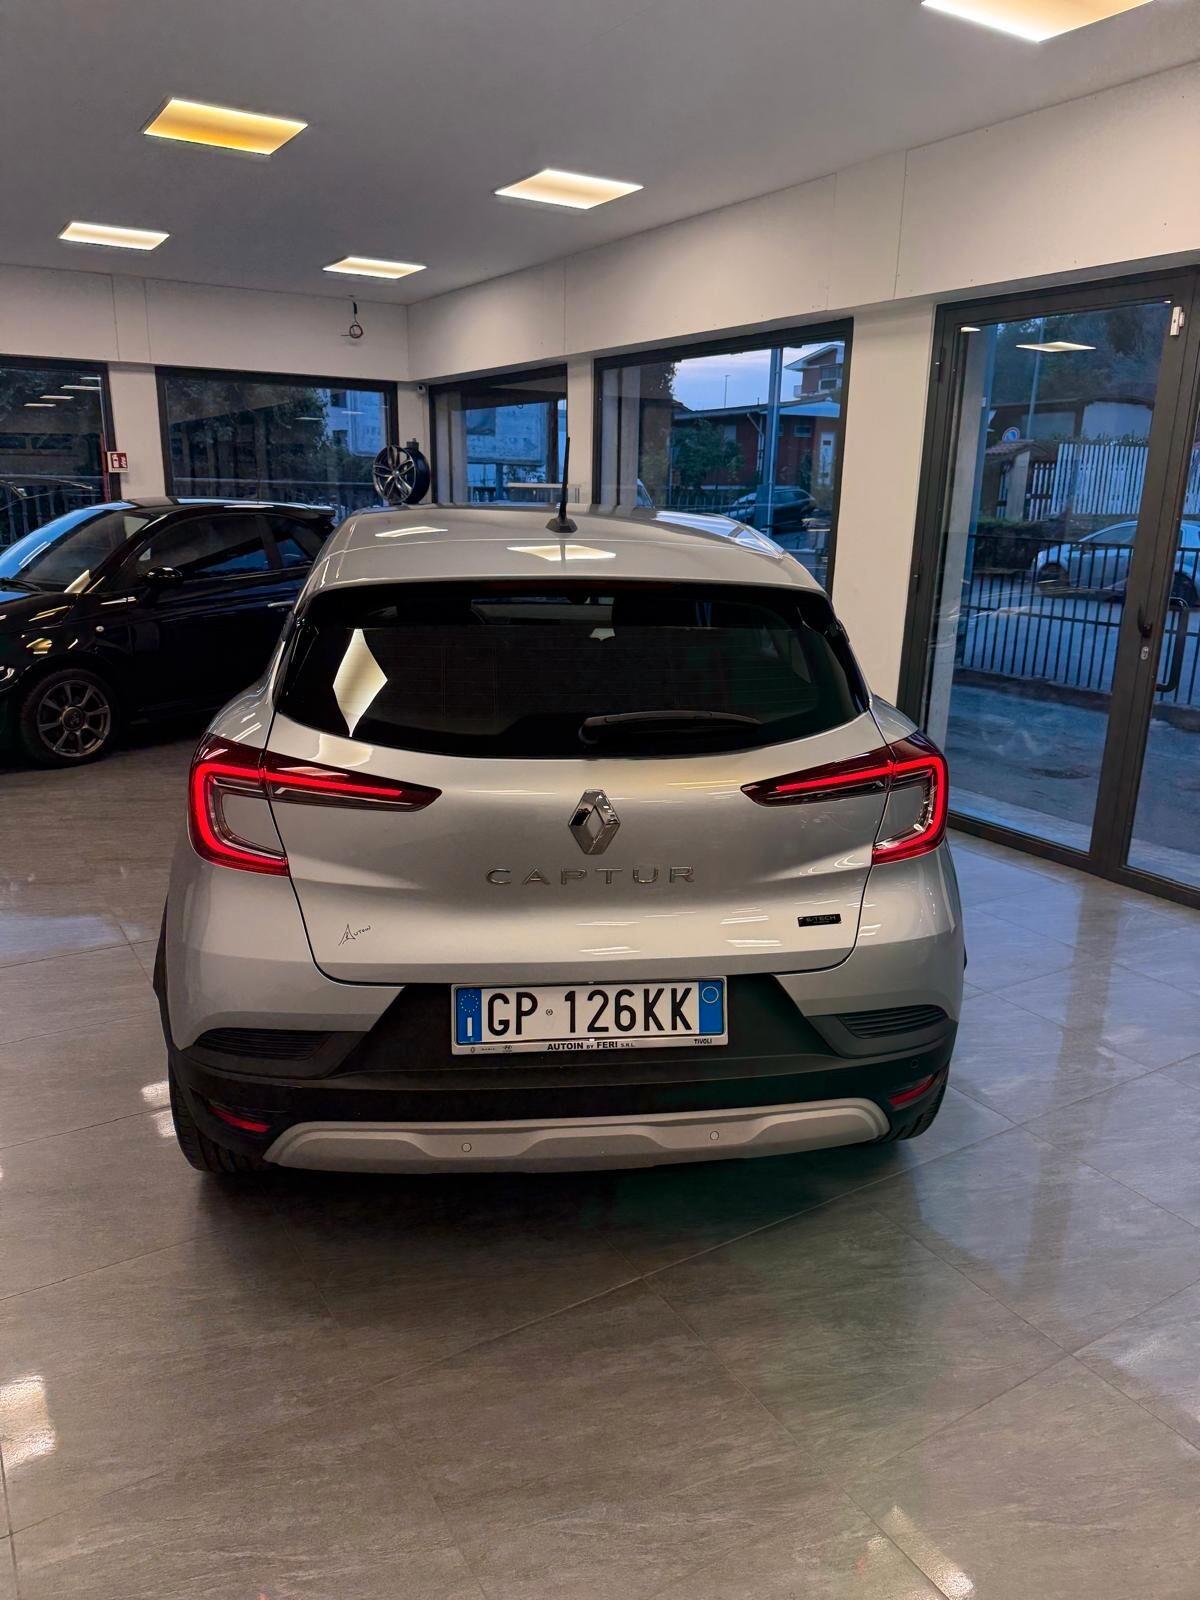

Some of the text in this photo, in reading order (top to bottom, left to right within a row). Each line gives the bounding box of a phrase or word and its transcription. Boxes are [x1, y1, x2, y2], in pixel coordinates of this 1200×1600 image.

[485, 866, 695, 886] CAPTUR
[487, 987, 693, 1036] GP 126KK
[547, 1042, 584, 1051] AUTOIN
[596, 1041, 618, 1049] FERI
